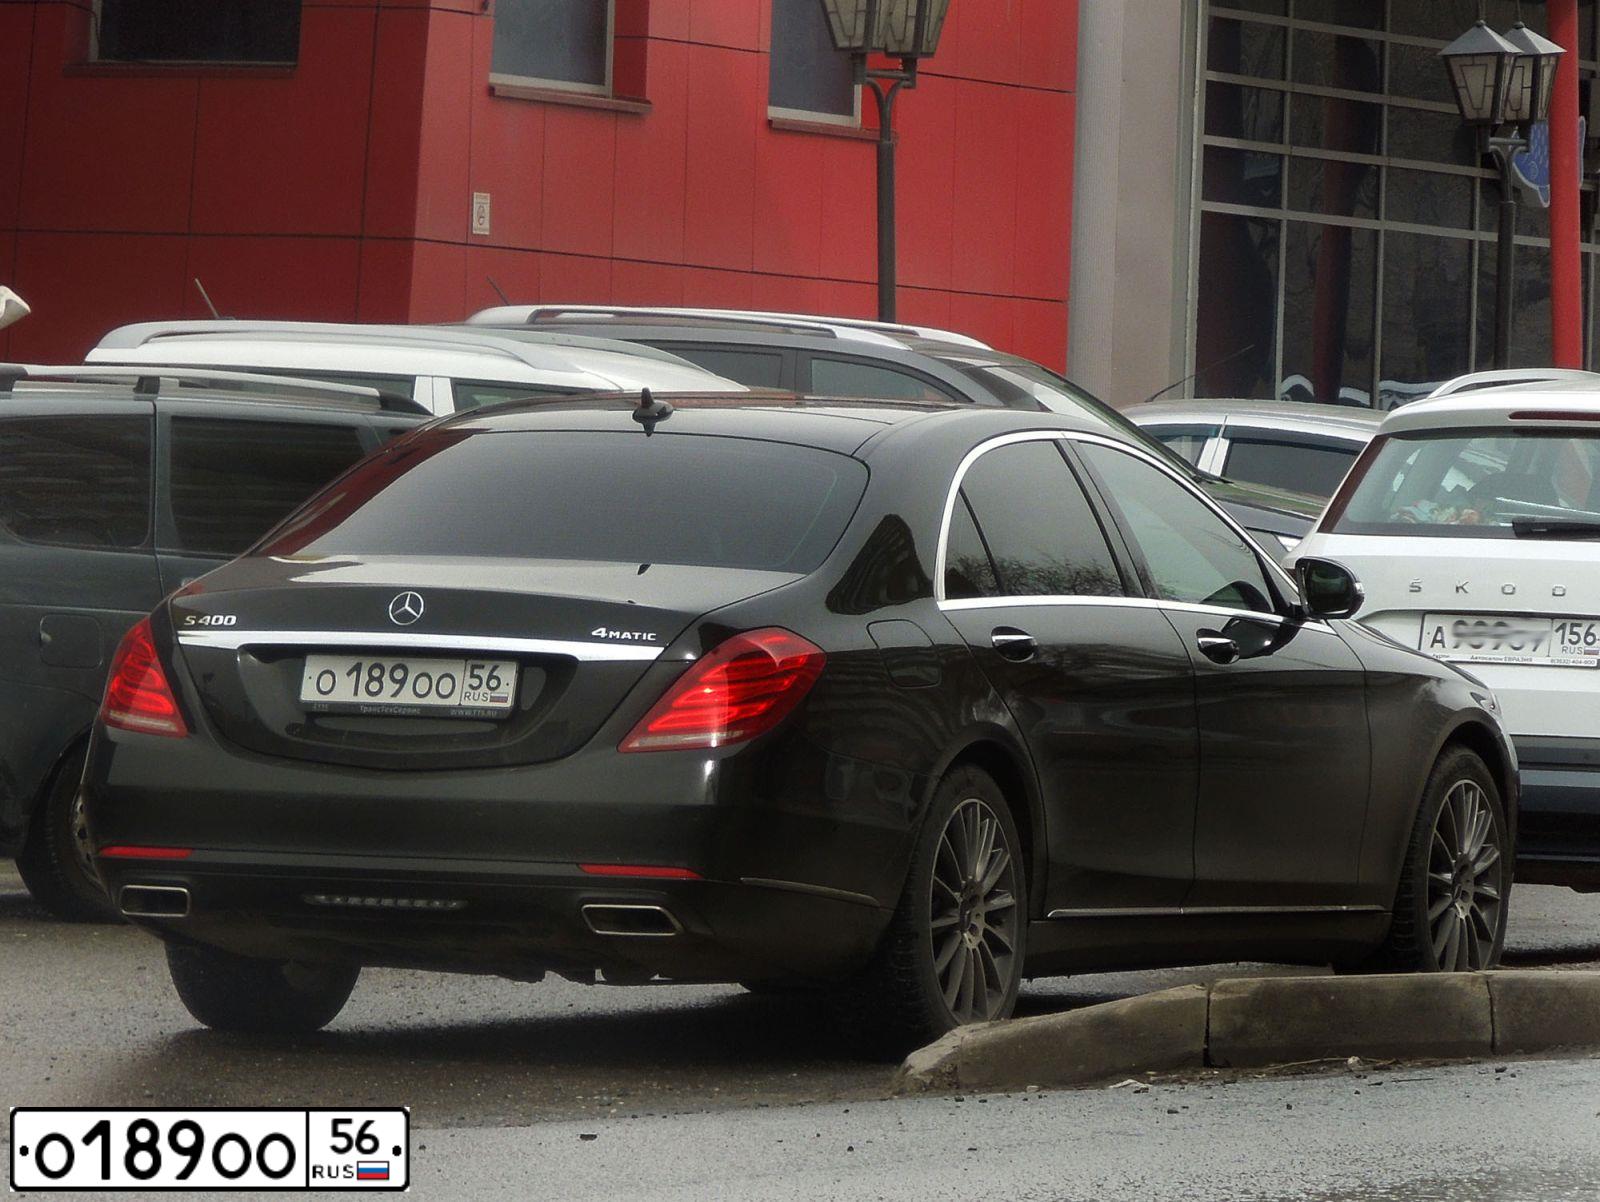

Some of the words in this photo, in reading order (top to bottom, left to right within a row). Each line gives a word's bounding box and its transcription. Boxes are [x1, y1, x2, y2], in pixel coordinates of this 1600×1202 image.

[591, 627, 657, 641] 4MATIC
[1554, 622, 1597, 646] 156
[1561, 646, 1583, 655] RUS
[468, 664, 502, 691] 56
[463, 691, 489, 702] RUS
